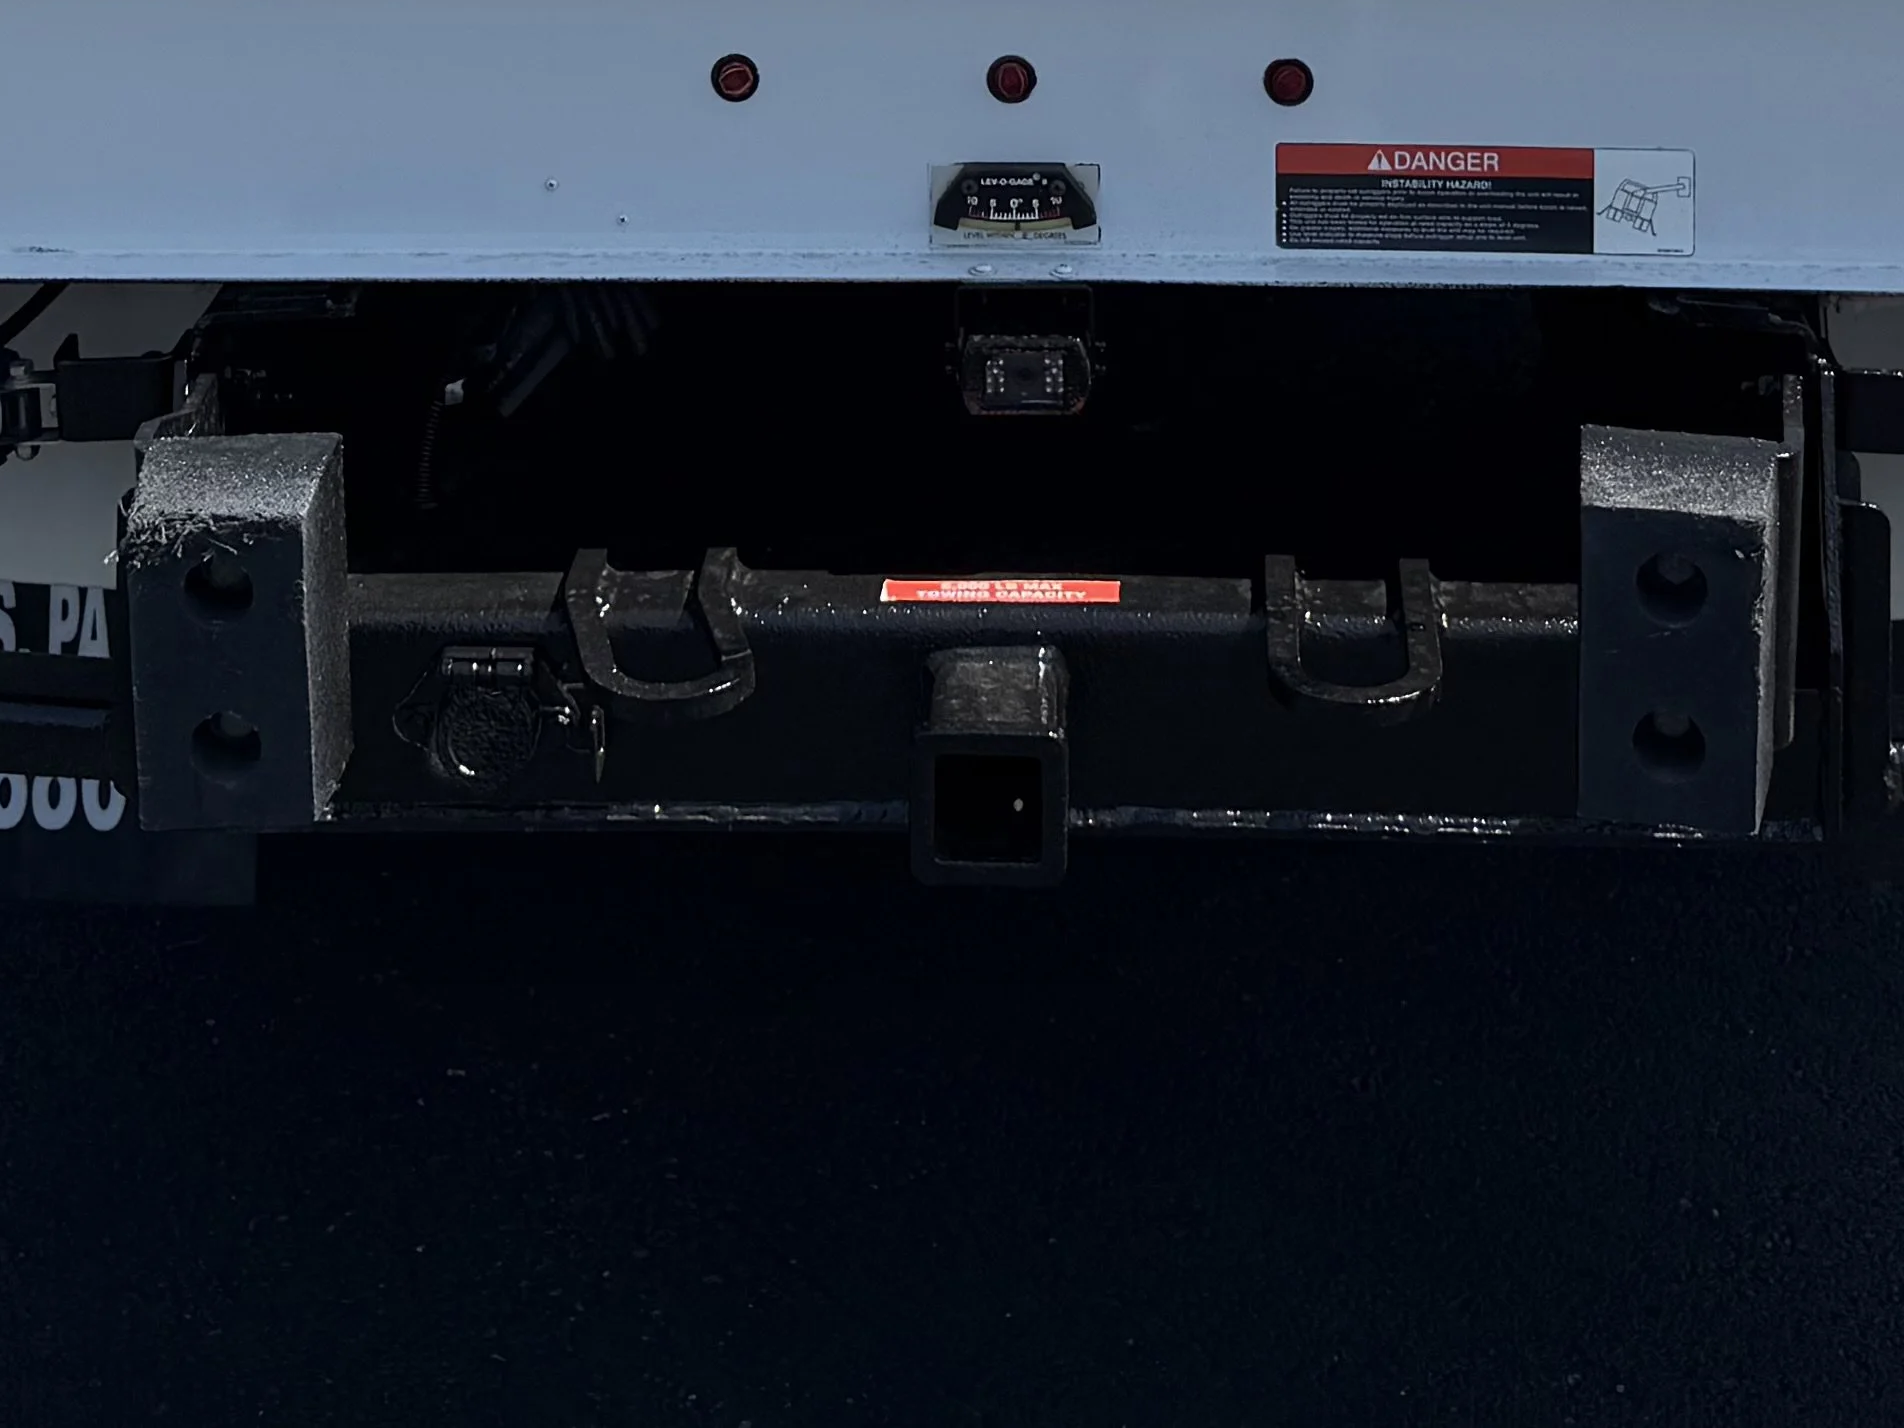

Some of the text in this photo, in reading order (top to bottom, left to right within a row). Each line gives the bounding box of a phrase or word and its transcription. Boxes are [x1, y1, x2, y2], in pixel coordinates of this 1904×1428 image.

[1394, 151, 1500, 172] DANGER
[1381, 179, 1492, 190] INSTABILITY HAZARD!
[964, 231, 984, 240] LEVEL
[1024, 582, 1063, 590] MAX
[916, 590, 1087, 600] TOWING CAPACITY
[49, 584, 111, 659] PA
